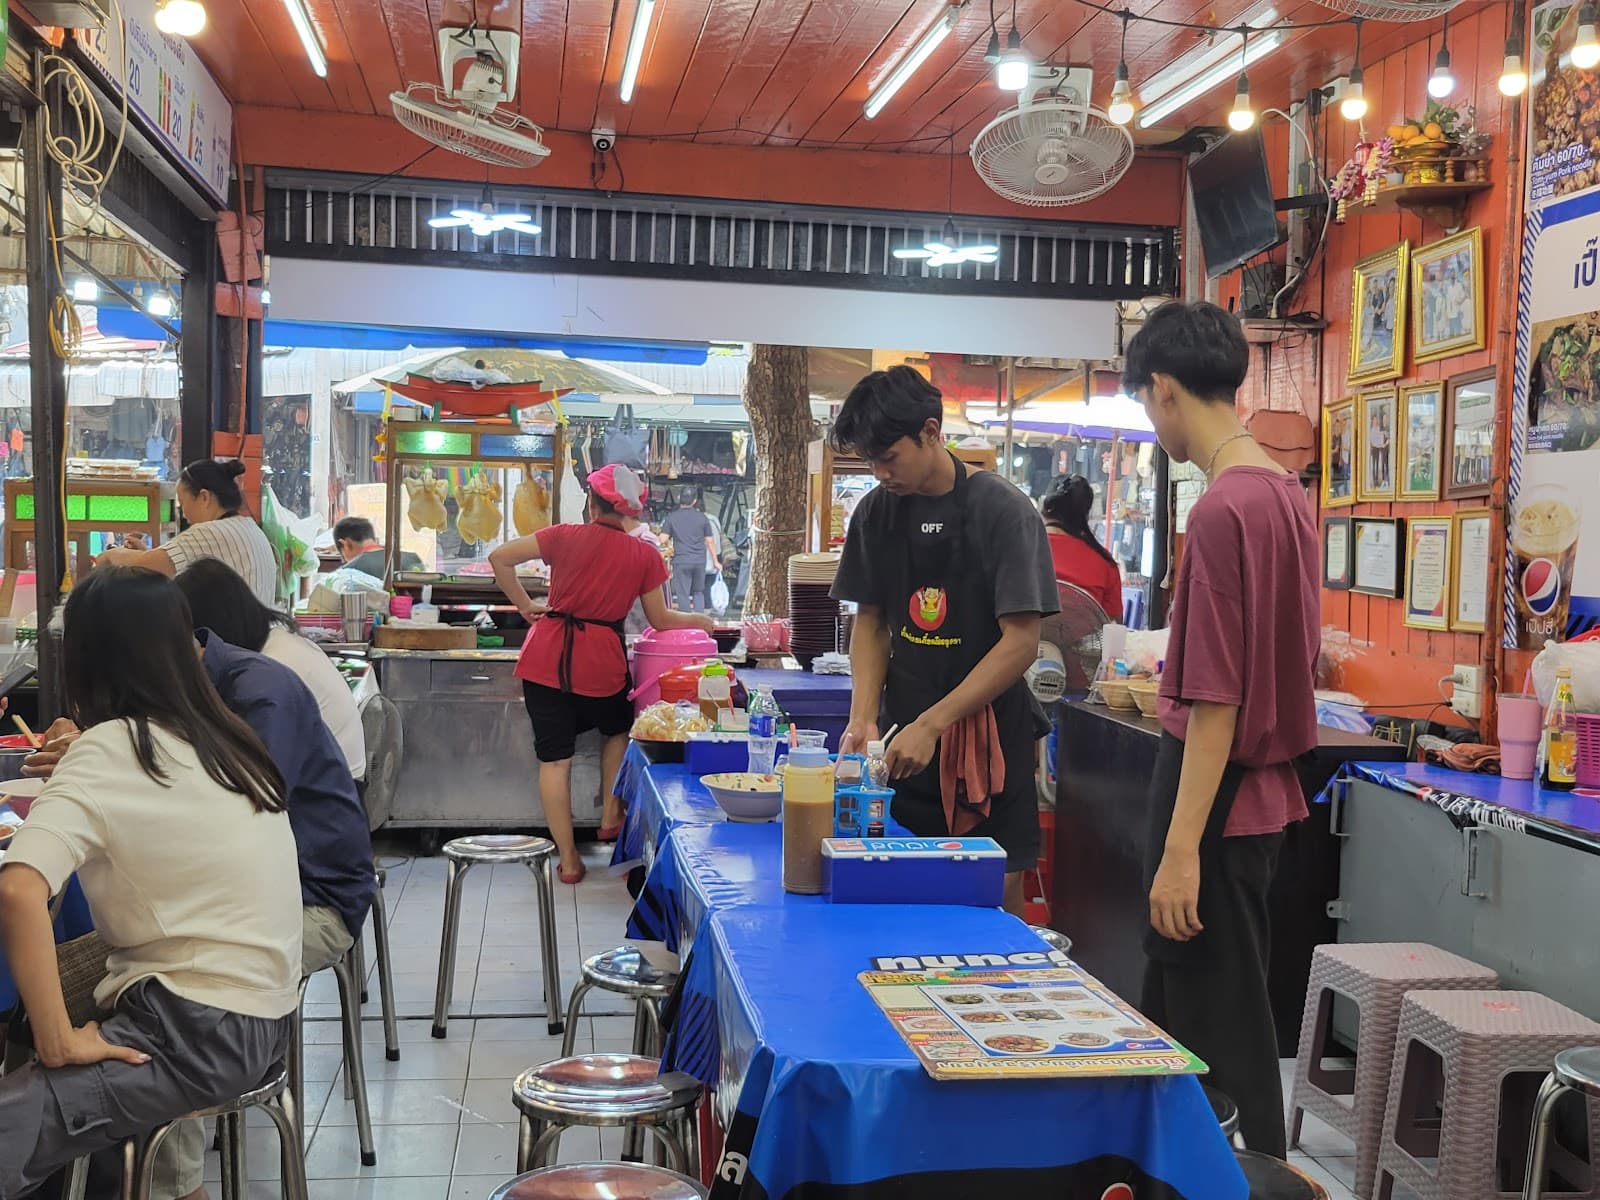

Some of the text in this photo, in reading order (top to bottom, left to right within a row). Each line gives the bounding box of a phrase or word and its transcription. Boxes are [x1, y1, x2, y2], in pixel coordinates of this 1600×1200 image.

[129, 58, 140, 95] 20
[172, 109, 182, 142] 20
[194, 136, 203, 166] 25
[216, 163, 224, 190] 10
[921, 523, 943, 533] OFF
